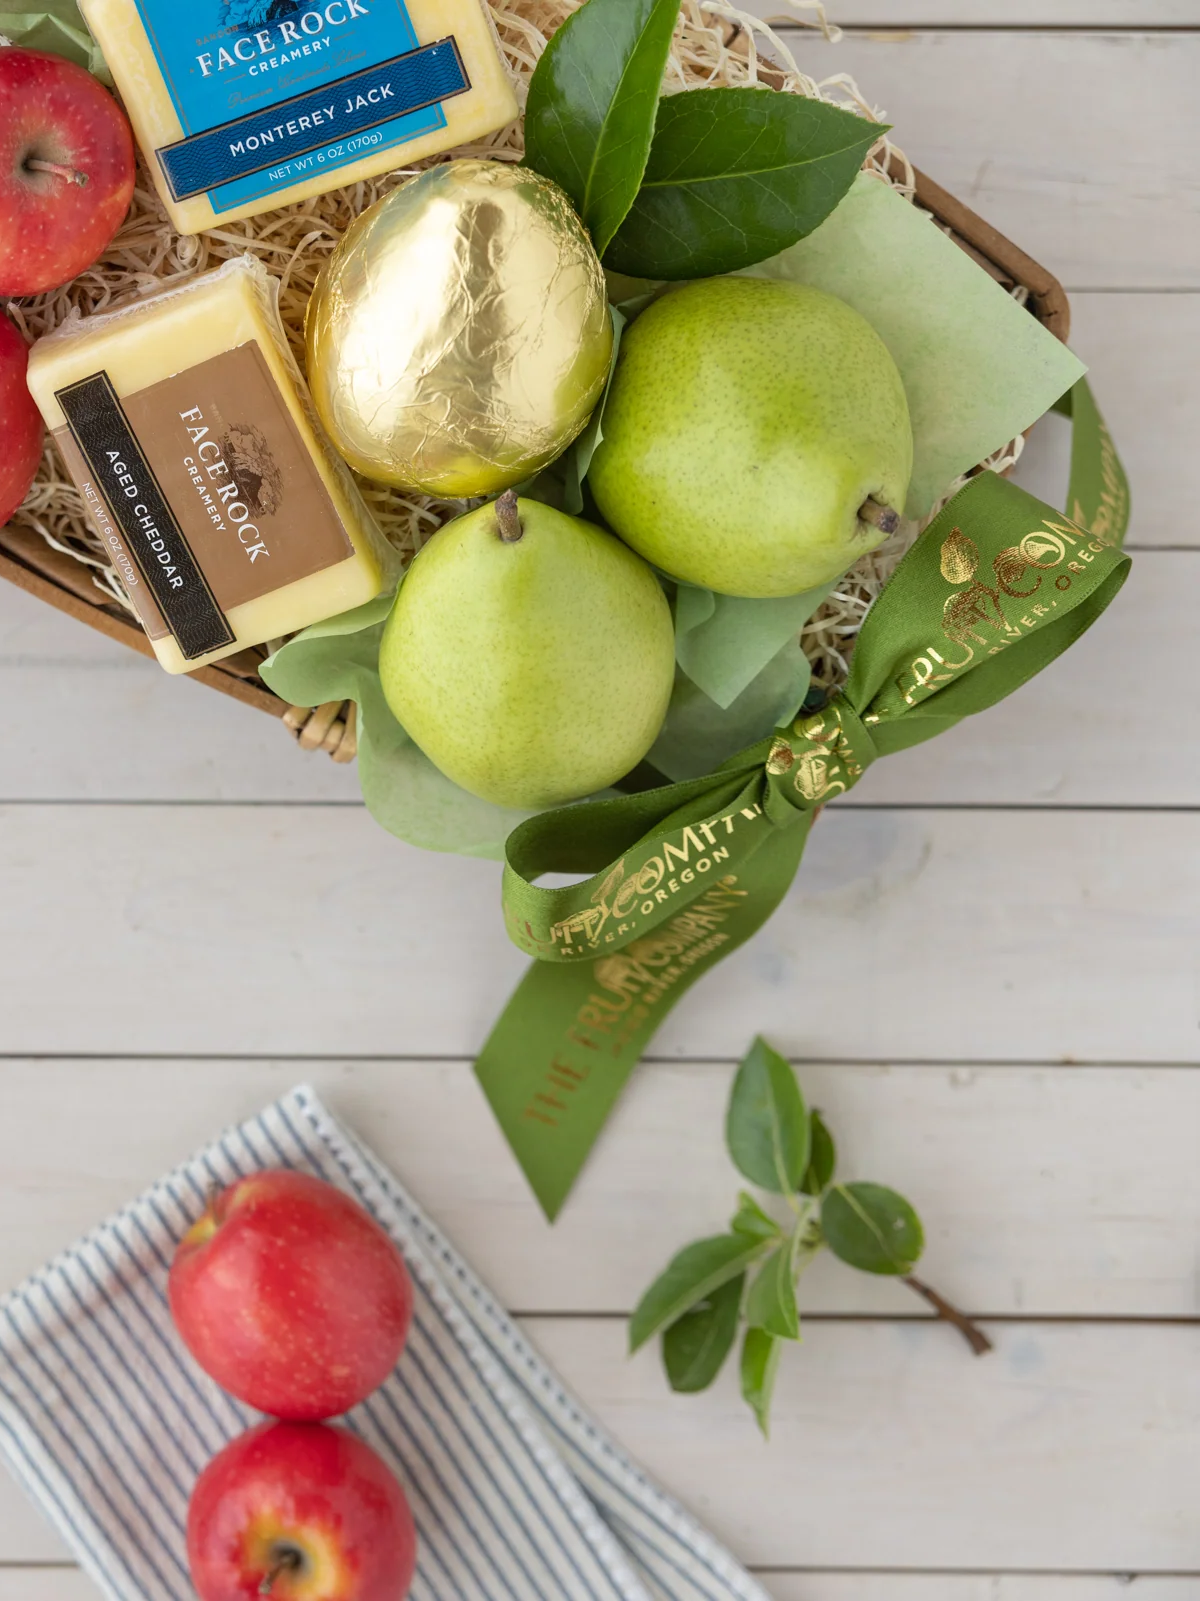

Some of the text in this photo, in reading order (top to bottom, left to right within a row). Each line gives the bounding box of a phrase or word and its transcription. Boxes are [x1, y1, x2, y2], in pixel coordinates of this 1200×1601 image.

[196, 0, 370, 78] FACE ROCK
[248, 36, 332, 77] CREAMERY
[229, 83, 395, 157] MONTEREY JACK
[268, 131, 384, 182] NET WT 6 OZ (170g)
[105, 450, 184, 590] AGED CHEDDAR
[179, 404, 271, 565] FACE ROCK
[183, 456, 227, 532] CREAMERY
[82, 482, 139, 586] NET WT 6 OZ (170g)
[640, 846, 730, 916] OREGON
[522, 1050, 591, 1127] THE
